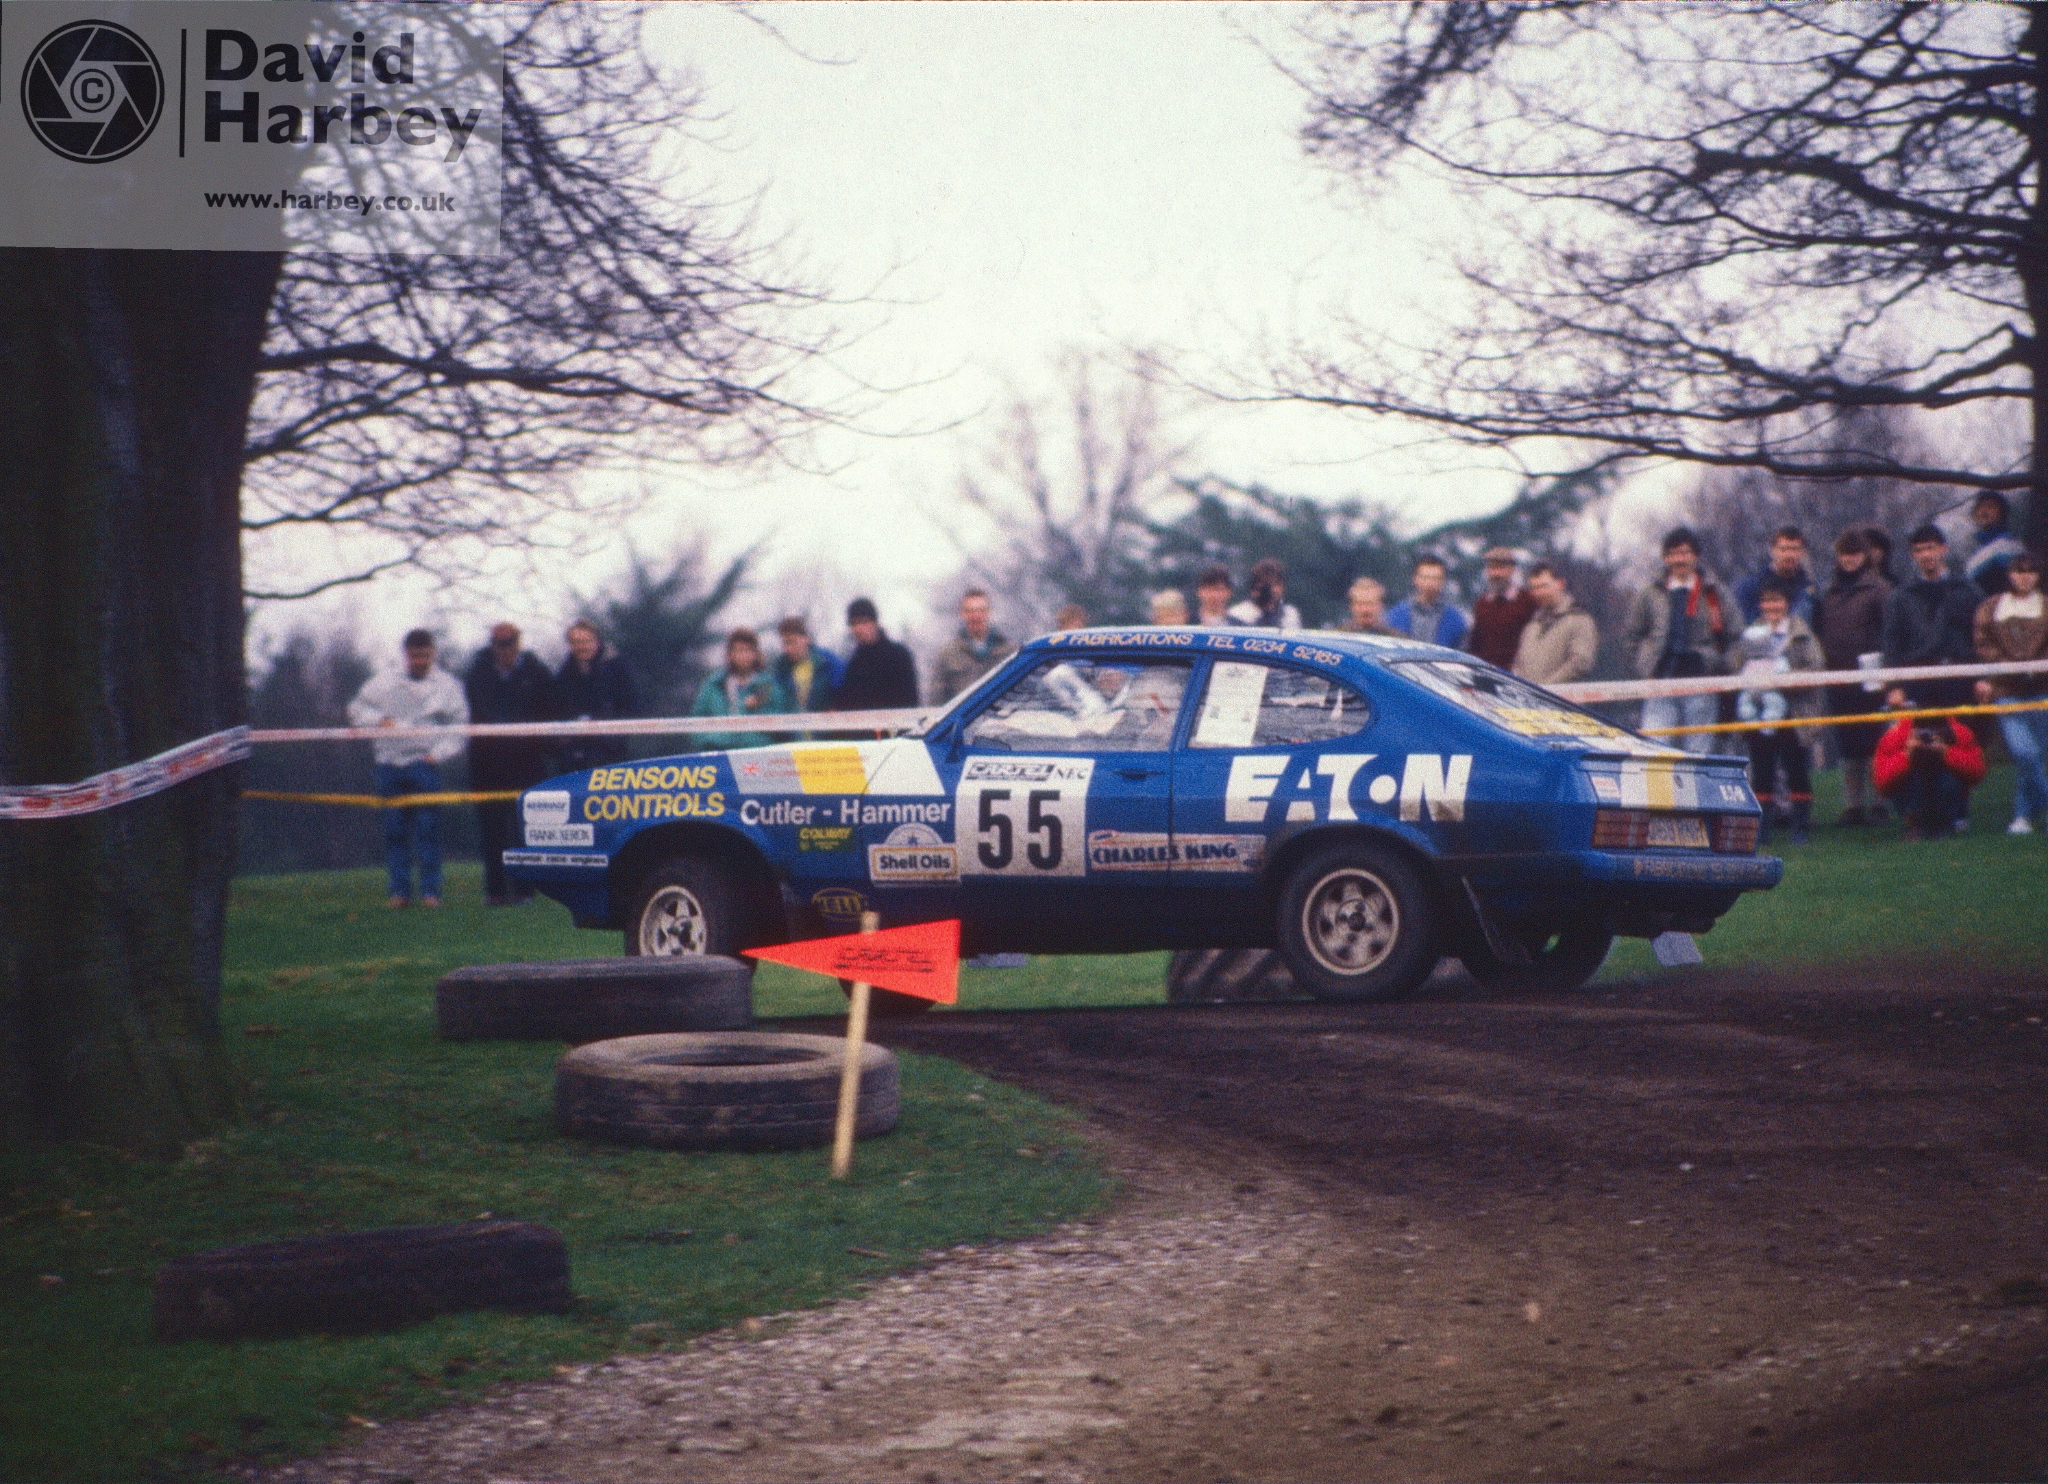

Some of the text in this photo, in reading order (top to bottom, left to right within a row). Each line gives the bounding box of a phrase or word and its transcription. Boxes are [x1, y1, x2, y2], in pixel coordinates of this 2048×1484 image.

[1069, 634, 1193, 646] FABRICATIONS
[1206, 635, 1236, 649] TEL
[1243, 639, 1287, 654] 0234
[588, 765, 717, 791] BENSONS
[1225, 754, 1474, 821] EATON
[583, 793, 725, 821] CONTROLS
[740, 799, 815, 825] Cutler
[840, 799, 951, 824] Hammer
[978, 788, 1062, 870] 55
[880, 855, 950, 870] Shell Oils
[1093, 844, 1180, 864] CHARLES
[1185, 843, 1237, 859] KING
